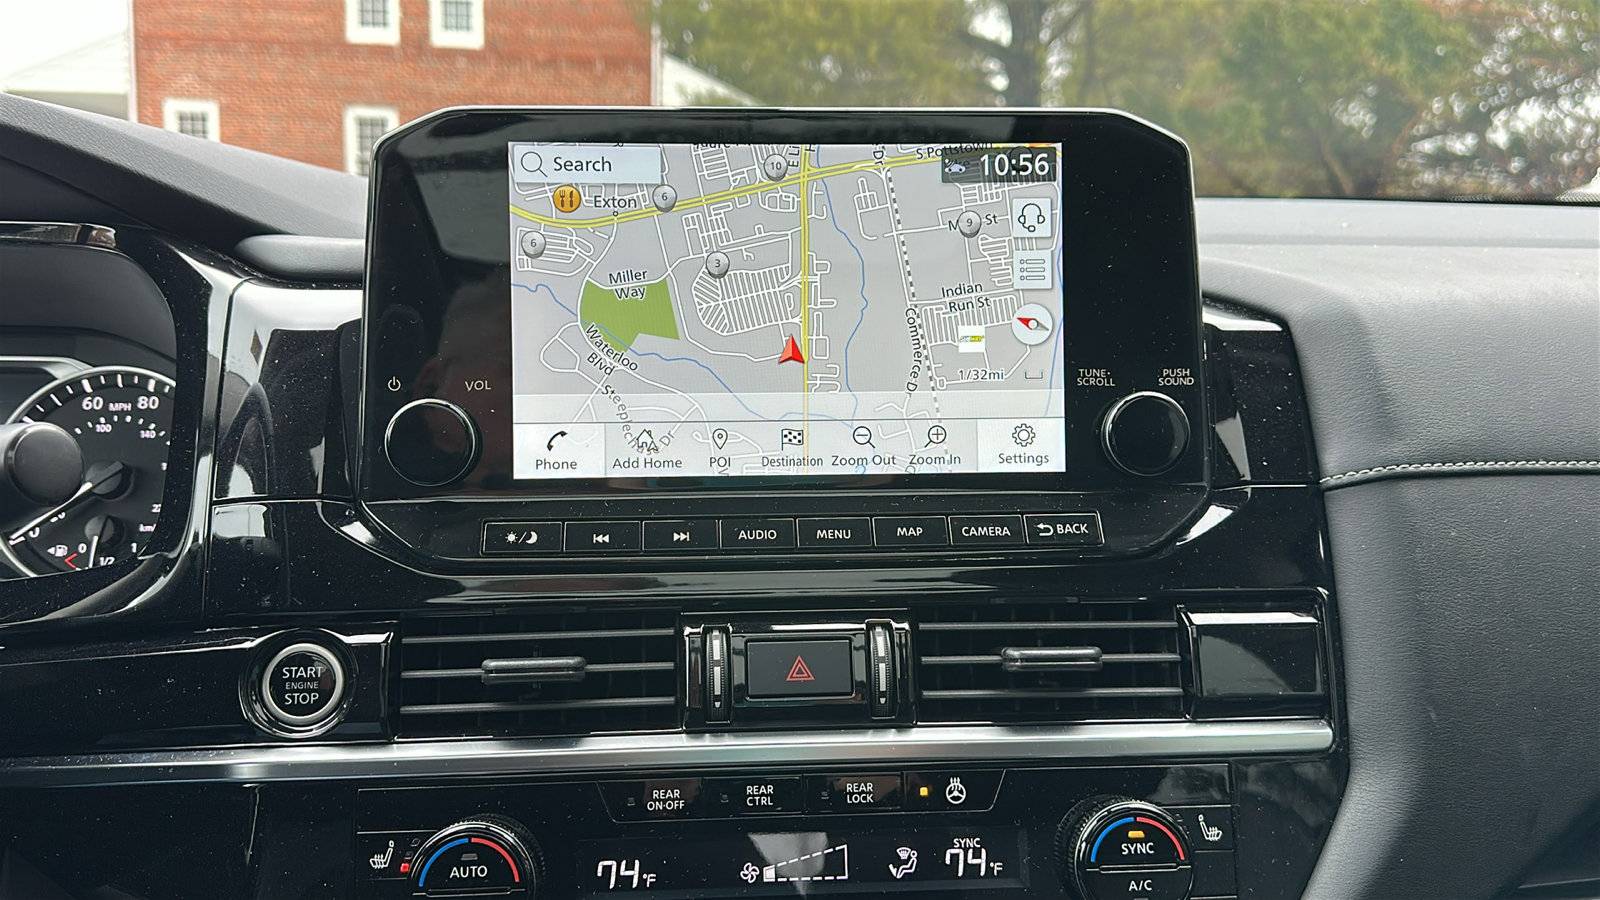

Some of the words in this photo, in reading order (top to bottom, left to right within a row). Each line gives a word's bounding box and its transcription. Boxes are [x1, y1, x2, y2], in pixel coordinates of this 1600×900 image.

[916, 149, 924, 159] S
[927, 143, 993, 159] Pottstown
[873, 150, 884, 165] Dr
[553, 156, 612, 172] Search
[770, 161, 782, 170] 10
[980, 153, 1050, 176] 10:56
[594, 196, 637, 208] Exton
[662, 192, 668, 201] 6
[966, 218, 973, 227] 9
[985, 214, 998, 225] St
[530, 239, 537, 247] 6
[714, 259, 721, 268] 3
[608, 270, 648, 284] Miller
[615, 286, 646, 300] Way
[941, 282, 983, 298] Indian
[949, 299, 975, 313] Run
[977, 297, 991, 310] St
[586, 323, 639, 372] Waterloo
[905, 308, 923, 379] Commerce
[586, 352, 616, 376] Blvd
[959, 369, 1004, 381] 1/32mi
[1162, 368, 1190, 377] PUSH
[465, 380, 491, 391] VOL
[1077, 378, 1115, 387] SCROLL
[1158, 377, 1195, 386] SOUND
[82, 396, 104, 411] 60
[109, 402, 132, 412] MPH
[137, 396, 159, 410] 80
[659, 430, 675, 447] Dr
[535, 458, 578, 471] Phone
[612, 457, 639, 469] Add
[644, 457, 683, 469] Home
[709, 457, 731, 468] POI
[761, 456, 824, 467] Destination
[831, 455, 868, 466] Zoom
[872, 454, 897, 465] Out
[908, 454, 945, 465] Zoom
[950, 454, 961, 465] In
[998, 452, 1049, 466] Settings
[816, 529, 851, 539] MENU
[896, 526, 923, 537] MAP
[961, 526, 1011, 537] CAMERA
[1057, 523, 1089, 534] BACK
[738, 529, 777, 540] AUDIO
[78, 543, 87, 554] 0
[131, 542, 137, 552] 1
[282, 666, 324, 679] START
[285, 681, 319, 690] ENGINE
[284, 692, 320, 705] STOP
[746, 785, 774, 796] REAR
[846, 782, 874, 793] REAR
[652, 789, 680, 799] REAR
[846, 793, 874, 804] LOCK
[746, 796, 774, 806] CTRL
[953, 838, 981, 848] SYNC
[1121, 843, 1154, 855] SYNC
[450, 866, 488, 879] AUTO
[1128, 880, 1153, 892] A/C
